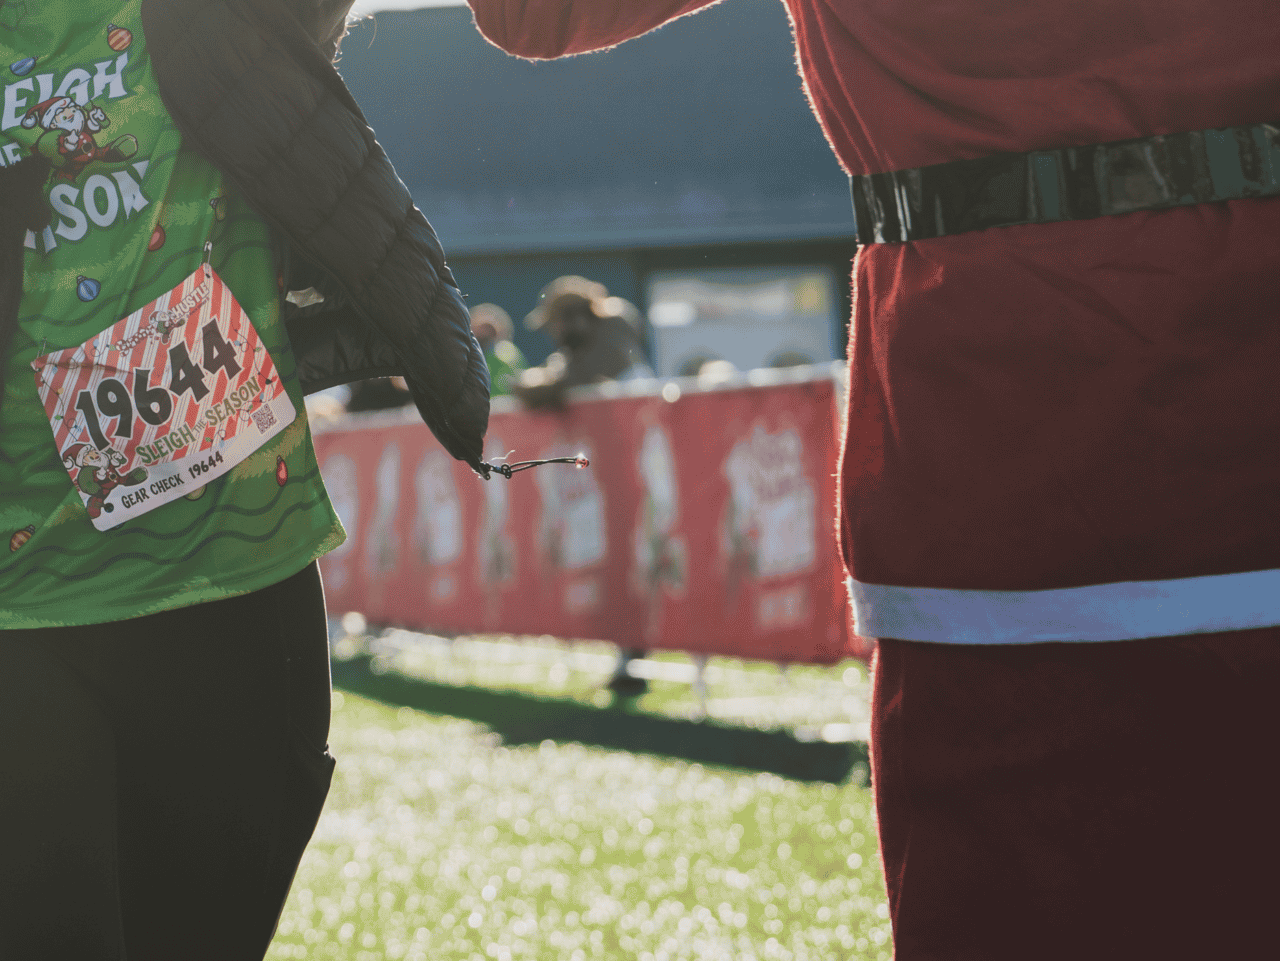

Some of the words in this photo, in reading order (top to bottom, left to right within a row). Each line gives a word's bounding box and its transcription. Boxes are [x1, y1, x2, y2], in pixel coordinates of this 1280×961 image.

[171, 282, 209, 319] HUSTLE
[76, 318, 242, 451] 19644
[135, 424, 196, 464] SLEIGH
[192, 418, 208, 435] THE
[204, 377, 261, 427] SEASON
[121, 487, 150, 509] GEAR
[150, 473, 185, 495] CHECK
[188, 450, 224, 479] 19644
